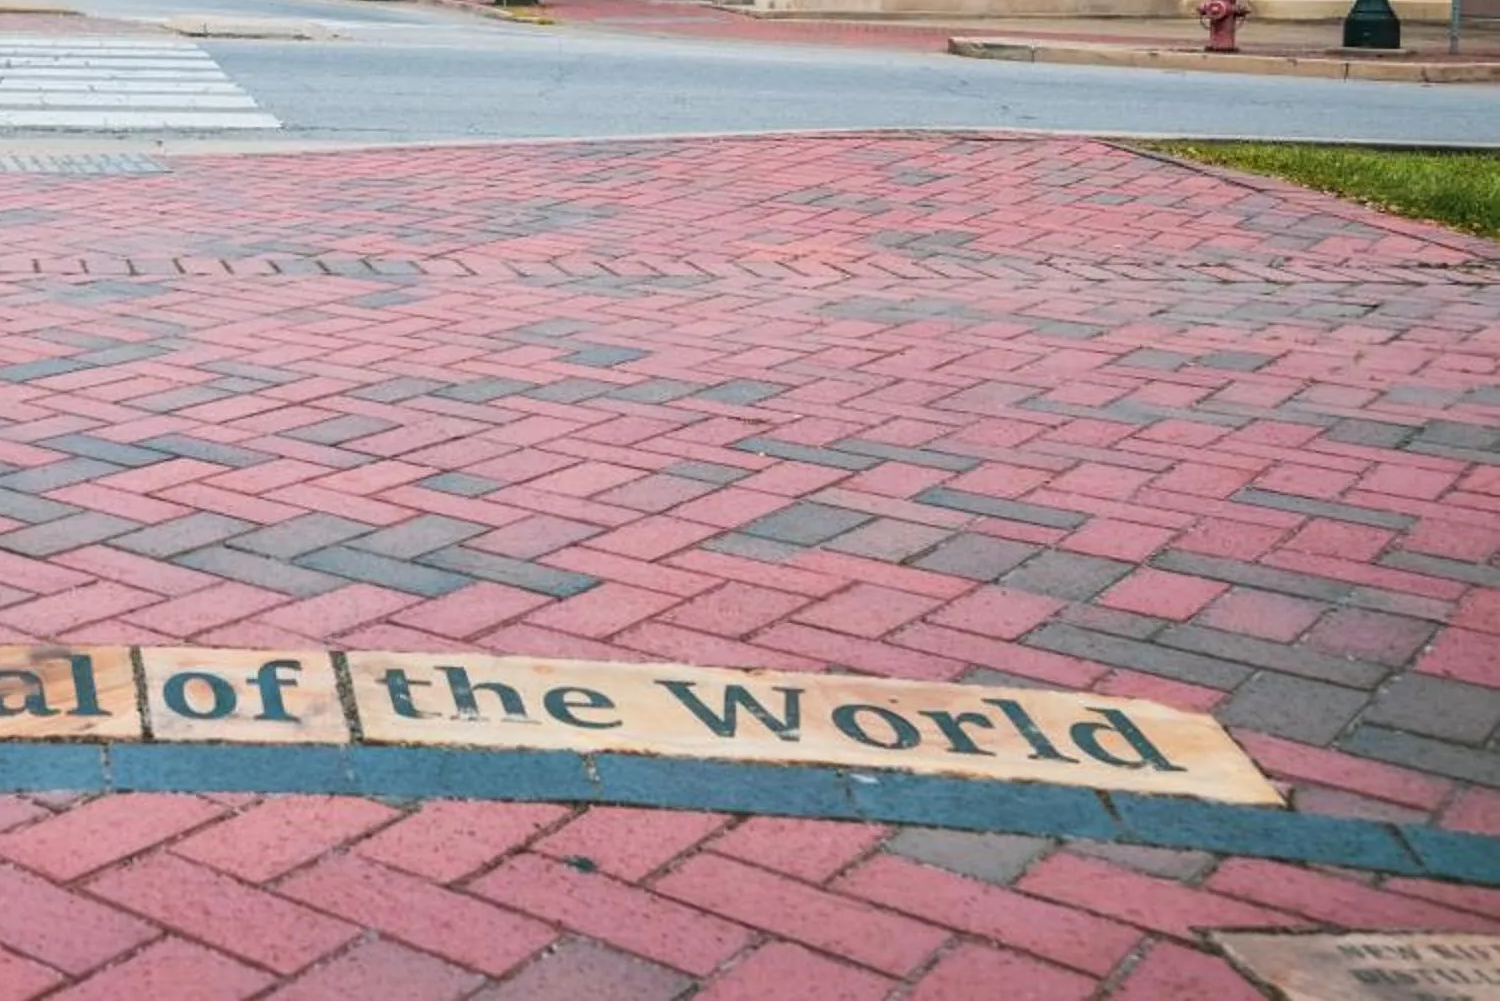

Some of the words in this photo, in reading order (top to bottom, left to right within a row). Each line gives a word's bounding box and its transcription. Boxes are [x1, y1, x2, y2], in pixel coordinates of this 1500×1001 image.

[162, 659, 304, 722] of
[380, 665, 623, 730] the
[656, 678, 1188, 773] World
